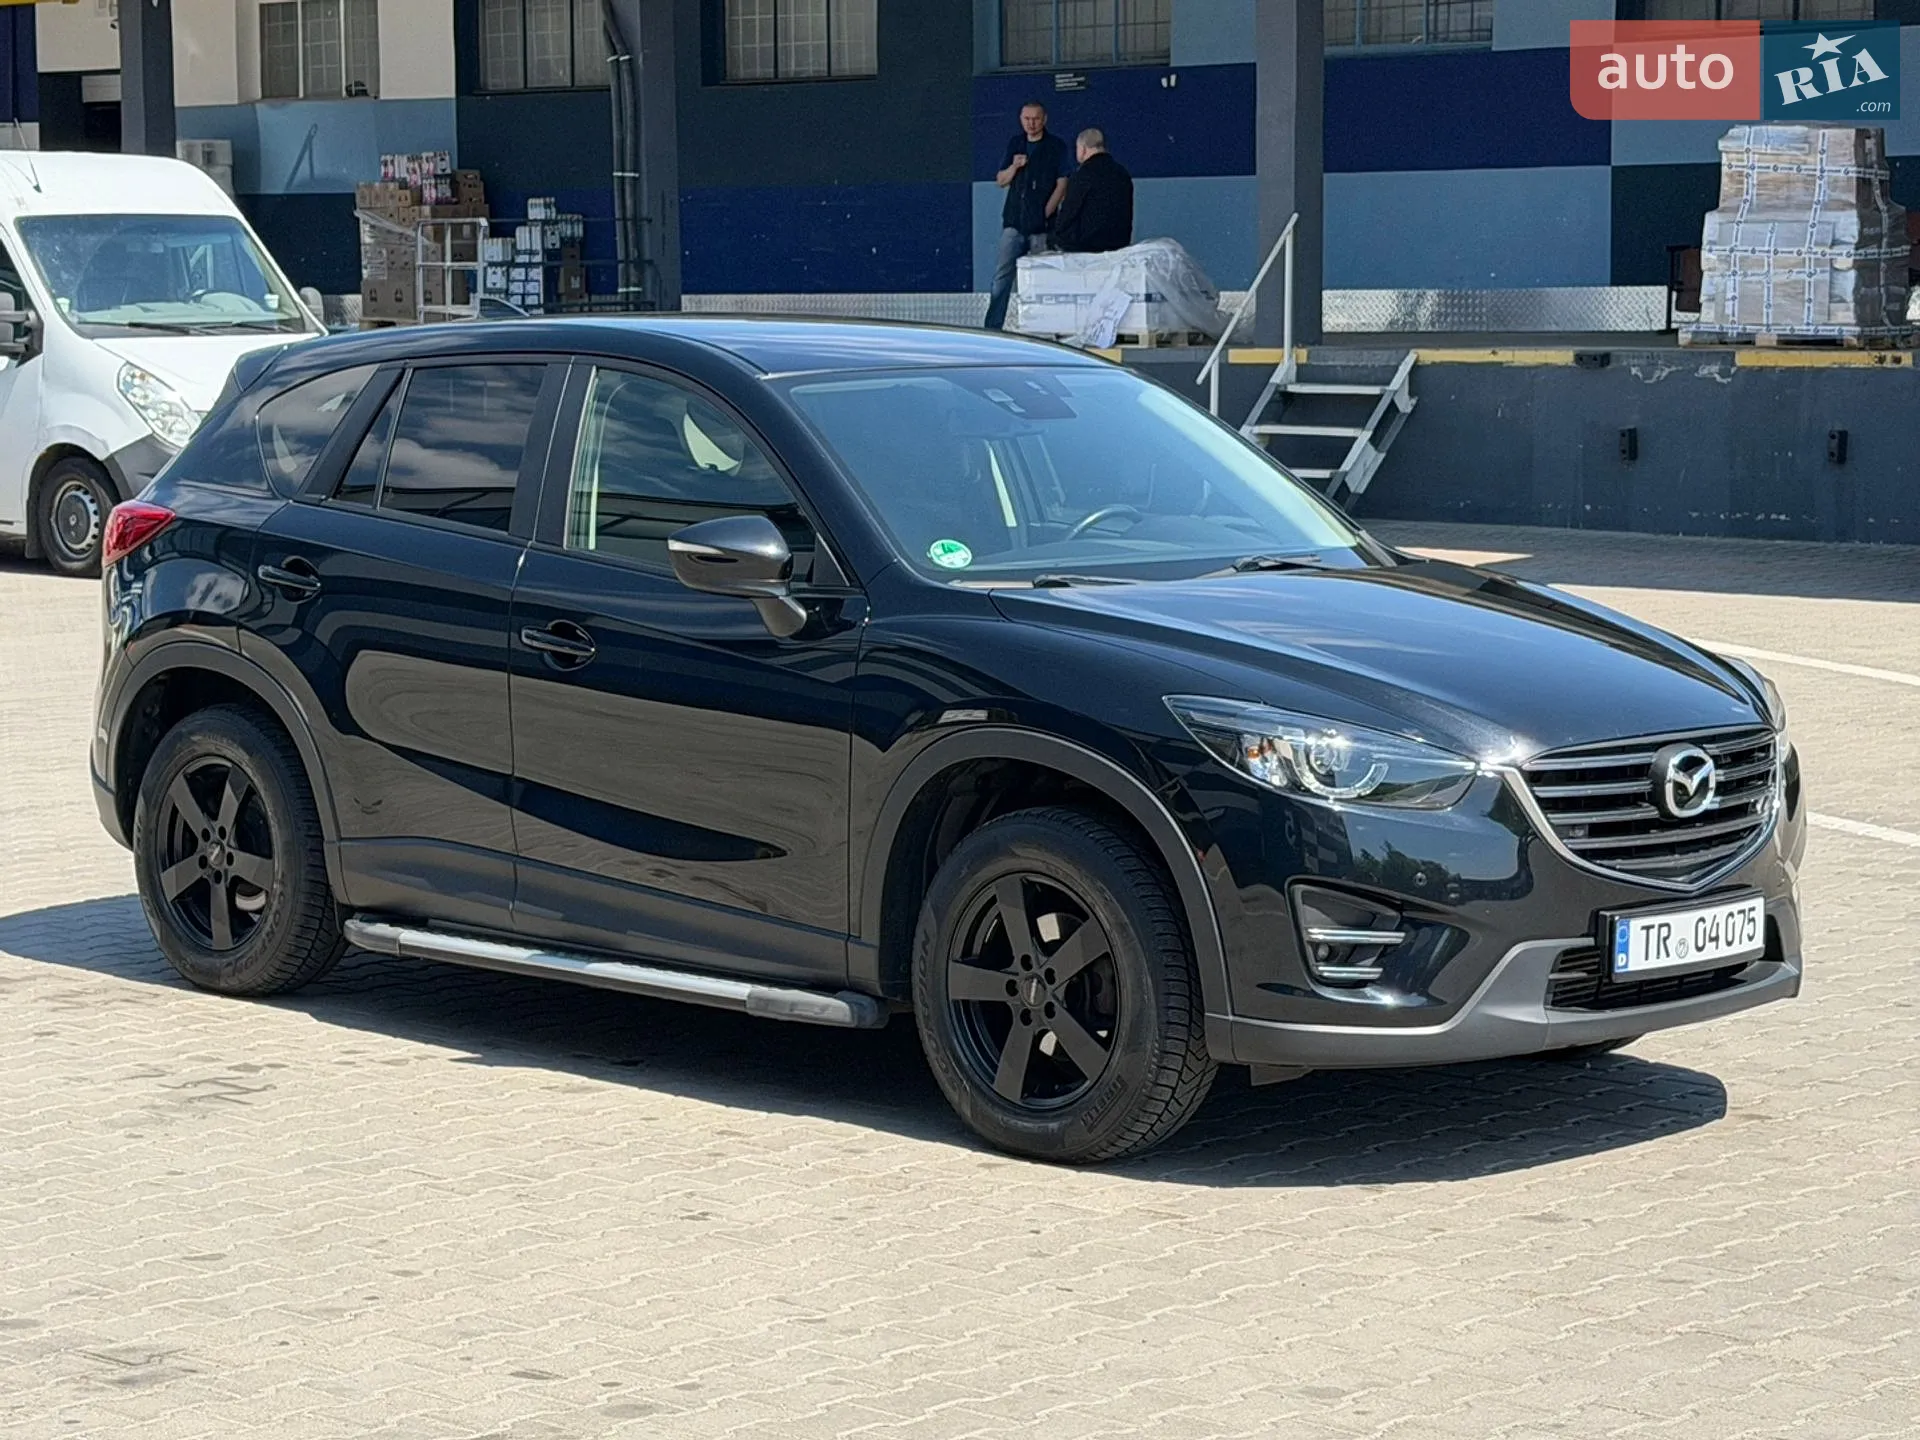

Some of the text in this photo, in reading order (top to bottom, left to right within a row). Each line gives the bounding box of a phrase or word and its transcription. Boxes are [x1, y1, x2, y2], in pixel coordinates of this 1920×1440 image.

[1640, 906, 1756, 961] TR 04075
[1618, 954, 1627, 966] D
